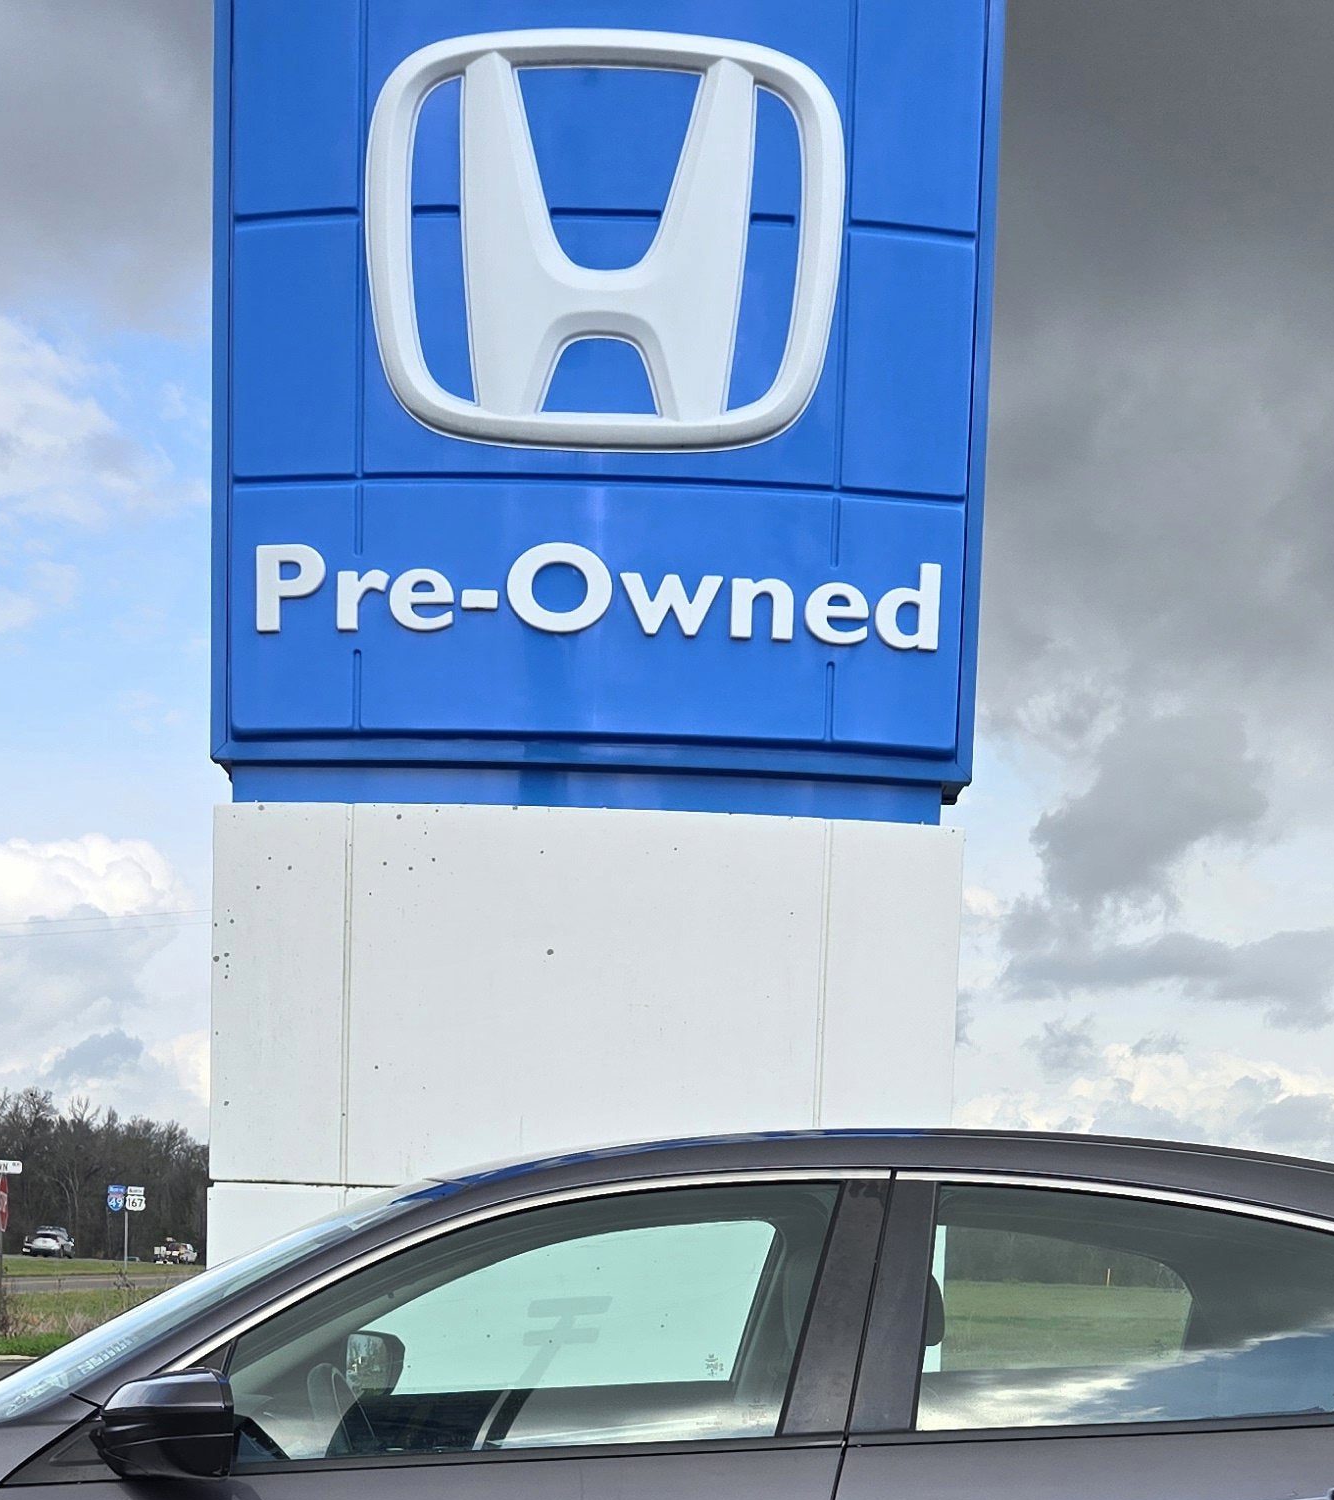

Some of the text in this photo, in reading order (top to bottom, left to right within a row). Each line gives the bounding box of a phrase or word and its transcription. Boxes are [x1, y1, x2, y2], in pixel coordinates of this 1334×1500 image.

[255, 541, 941, 652] Pre-Owned
[108, 1197, 123, 1208] 49
[128, 1197, 144, 1208] 167
